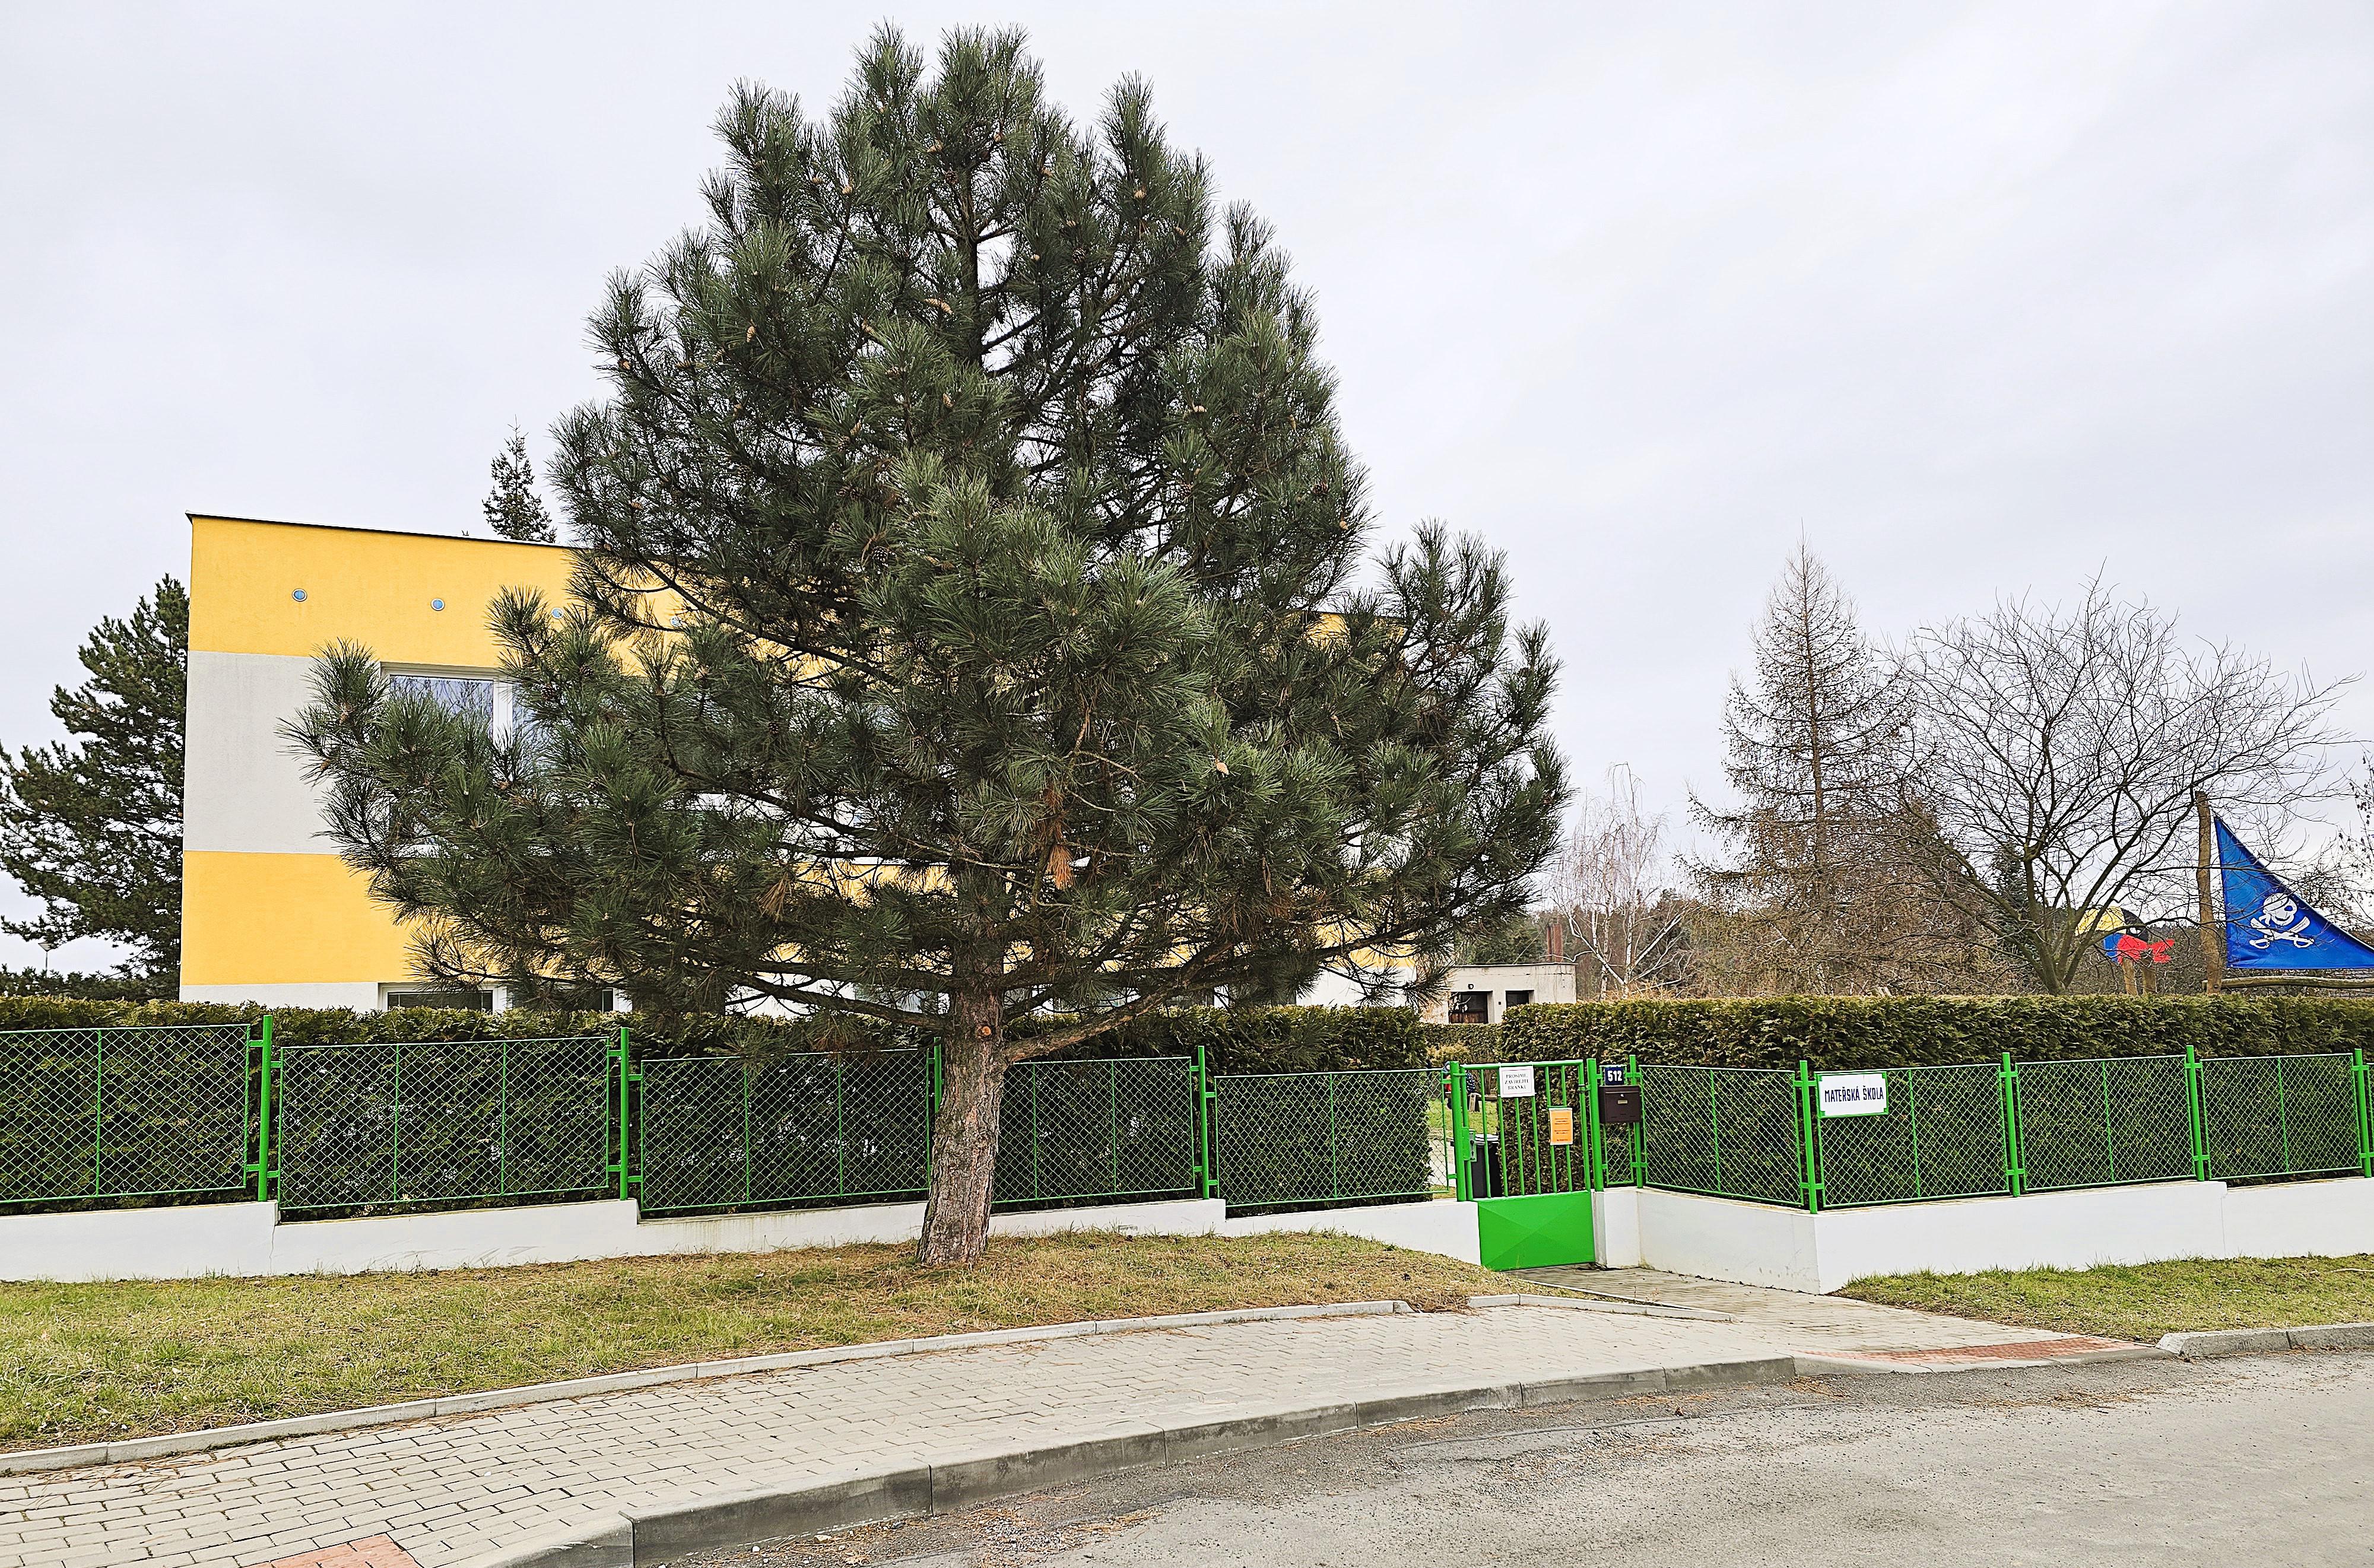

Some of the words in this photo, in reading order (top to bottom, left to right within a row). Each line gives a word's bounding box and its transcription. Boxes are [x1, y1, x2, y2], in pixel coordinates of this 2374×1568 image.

[1607, 1070, 1623, 1081] 512
[1824, 1085, 1861, 1103] MATEŘSKÁ
[1862, 1085, 1884, 1100] ŠKOLA
